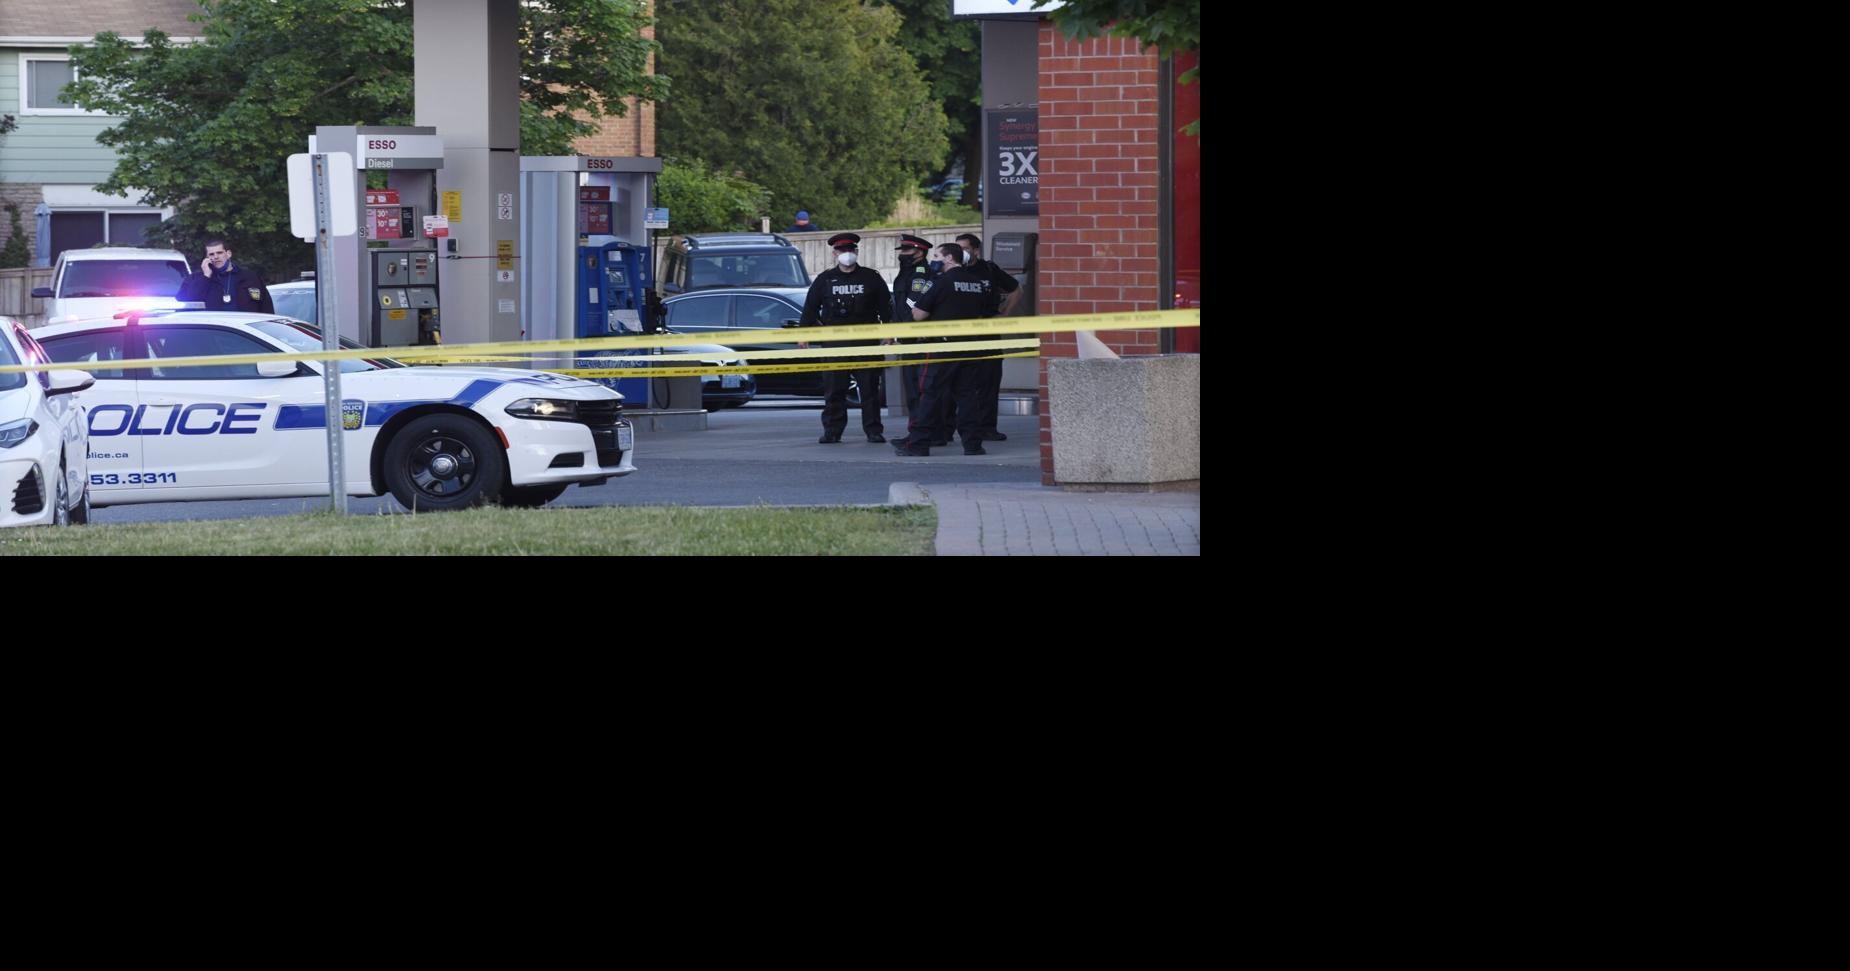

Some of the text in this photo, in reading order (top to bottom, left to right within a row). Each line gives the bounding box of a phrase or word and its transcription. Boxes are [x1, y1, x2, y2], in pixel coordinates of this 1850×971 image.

[368, 140, 397, 150] ESSO
[367, 158, 394, 168] Diesel
[587, 159, 613, 169] ESSO
[999, 151, 1038, 176] 3X
[999, 176, 1039, 185] CLEANER
[429, 253, 435, 263] 9
[639, 253, 646, 262] 7
[832, 284, 864, 295] POLICE
[954, 281, 983, 293] POLICE
[82, 402, 268, 436] OLICE
[91, 472, 177, 485] 53.3311
